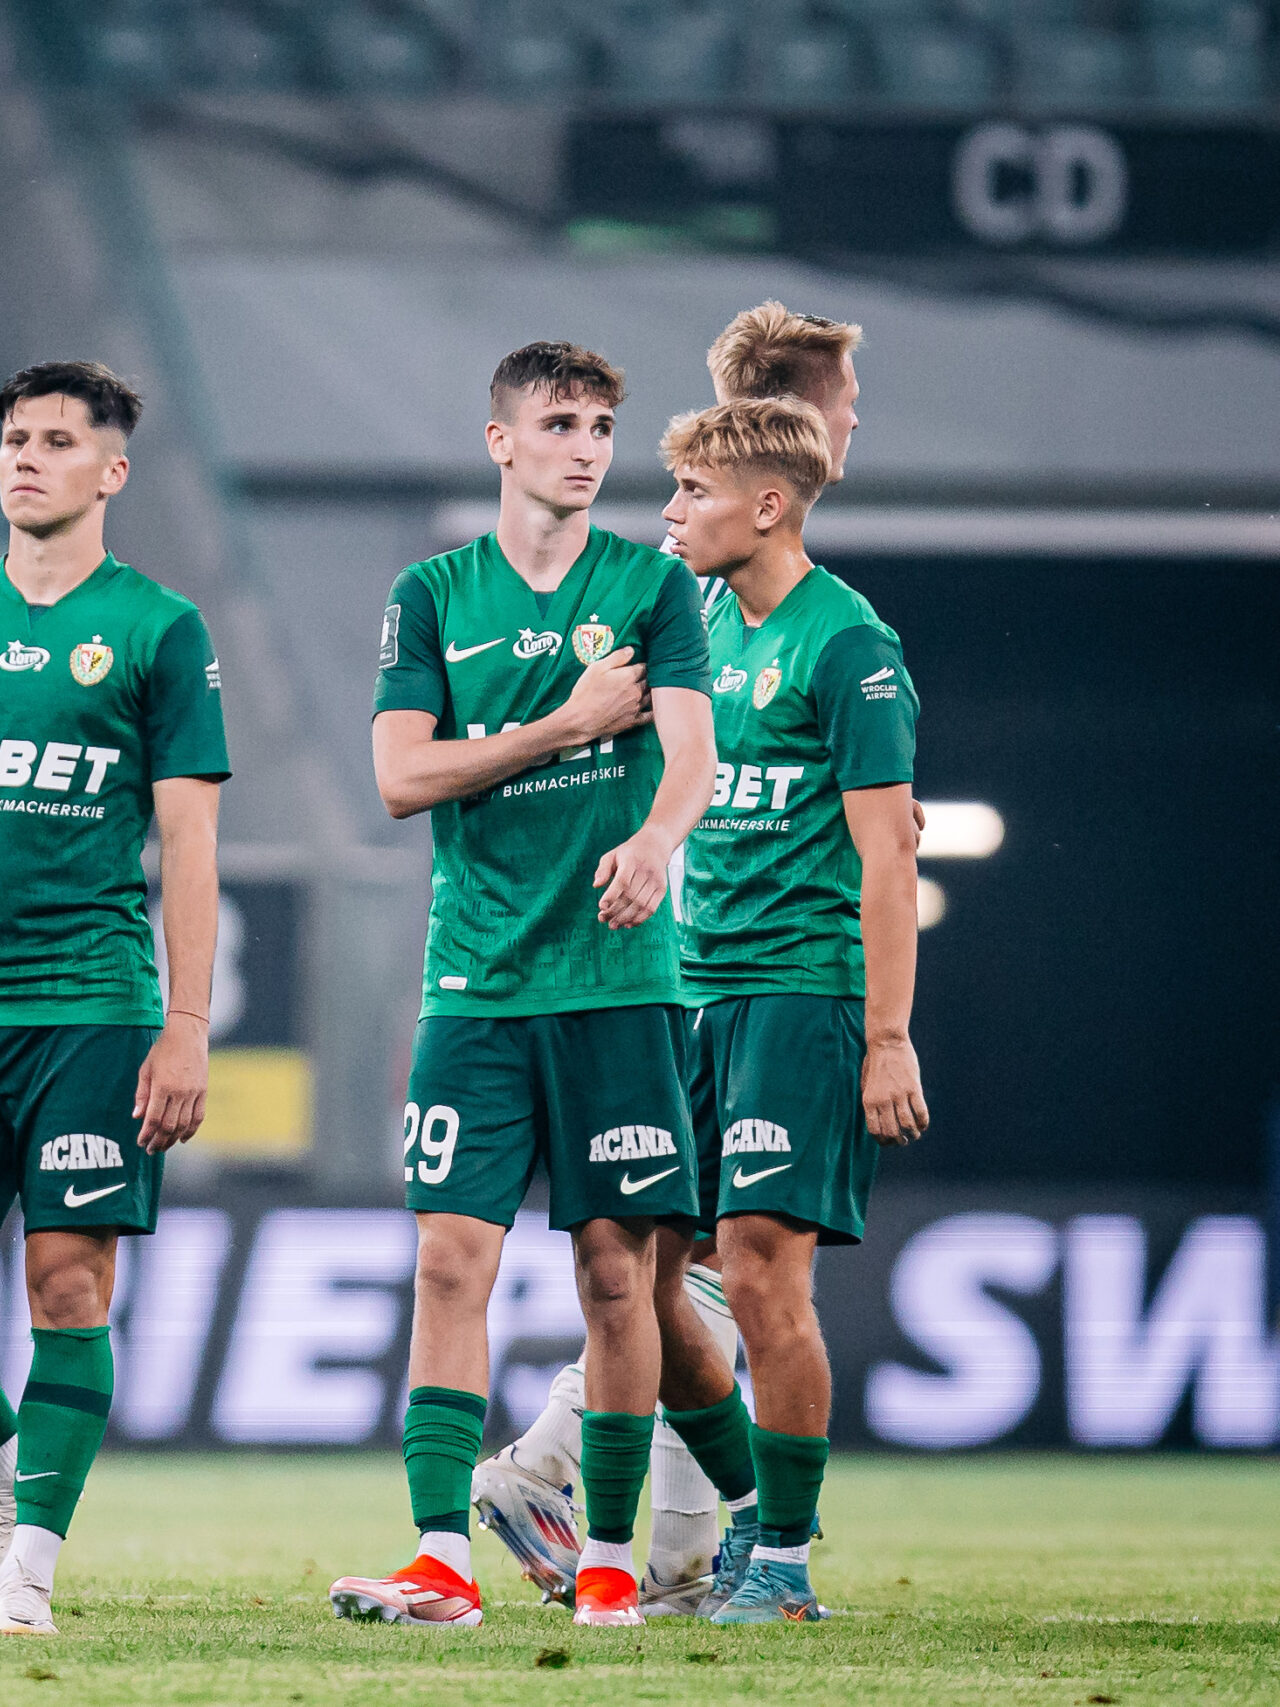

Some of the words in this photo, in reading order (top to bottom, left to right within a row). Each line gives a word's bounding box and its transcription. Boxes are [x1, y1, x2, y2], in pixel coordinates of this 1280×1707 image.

[954, 119, 1129, 244] CD
[865, 692, 897, 701] AIRPORT
[502, 765, 626, 798] BUKMACHERSKIE
[694, 818, 791, 832] UKMACHERSKIE
[39, 1133, 124, 1171] ACANA
[403, 1101, 460, 1185] 29
[588, 1124, 678, 1162] ACANA
[721, 1118, 792, 1158] ACANA
